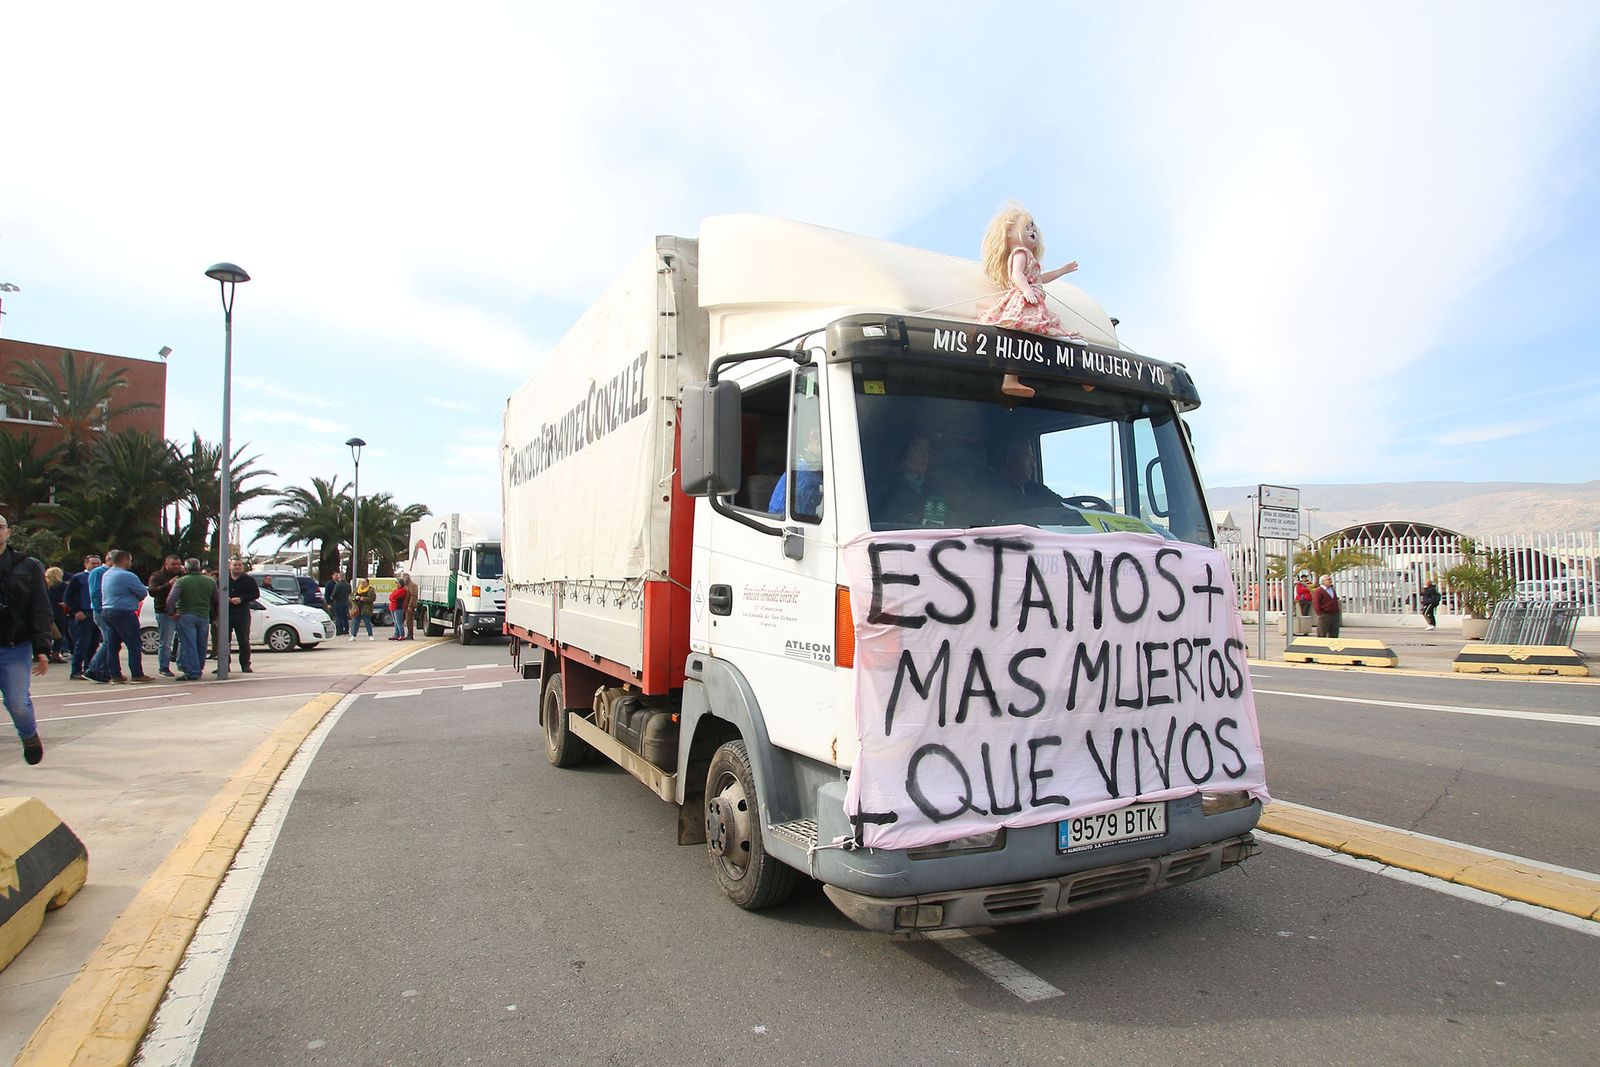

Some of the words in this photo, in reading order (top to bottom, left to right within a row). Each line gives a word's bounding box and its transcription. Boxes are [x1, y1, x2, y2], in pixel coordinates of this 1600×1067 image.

[933, 328, 968, 353] MIS
[976, 334, 988, 356] 2
[996, 335, 1050, 366] HIJOS,
[1056, 345, 1074, 368] MI
[1082, 350, 1131, 379] MUJER
[1134, 360, 1143, 381] Y
[1147, 364, 1165, 386] YO
[586, 350, 648, 445] GONZALEZ
[867, 537, 1185, 632] ESTAMOS
[785, 640, 831, 653] ATLEON
[813, 653, 831, 662] 120
[884, 639, 1047, 736] MAS
[1065, 637, 1248, 713] MUERTOS
[905, 736, 1070, 823] QUE
[1086, 716, 1247, 799] VIVOS
[1072, 813, 1118, 841] 9579
[1125, 807, 1157, 834] BTK
